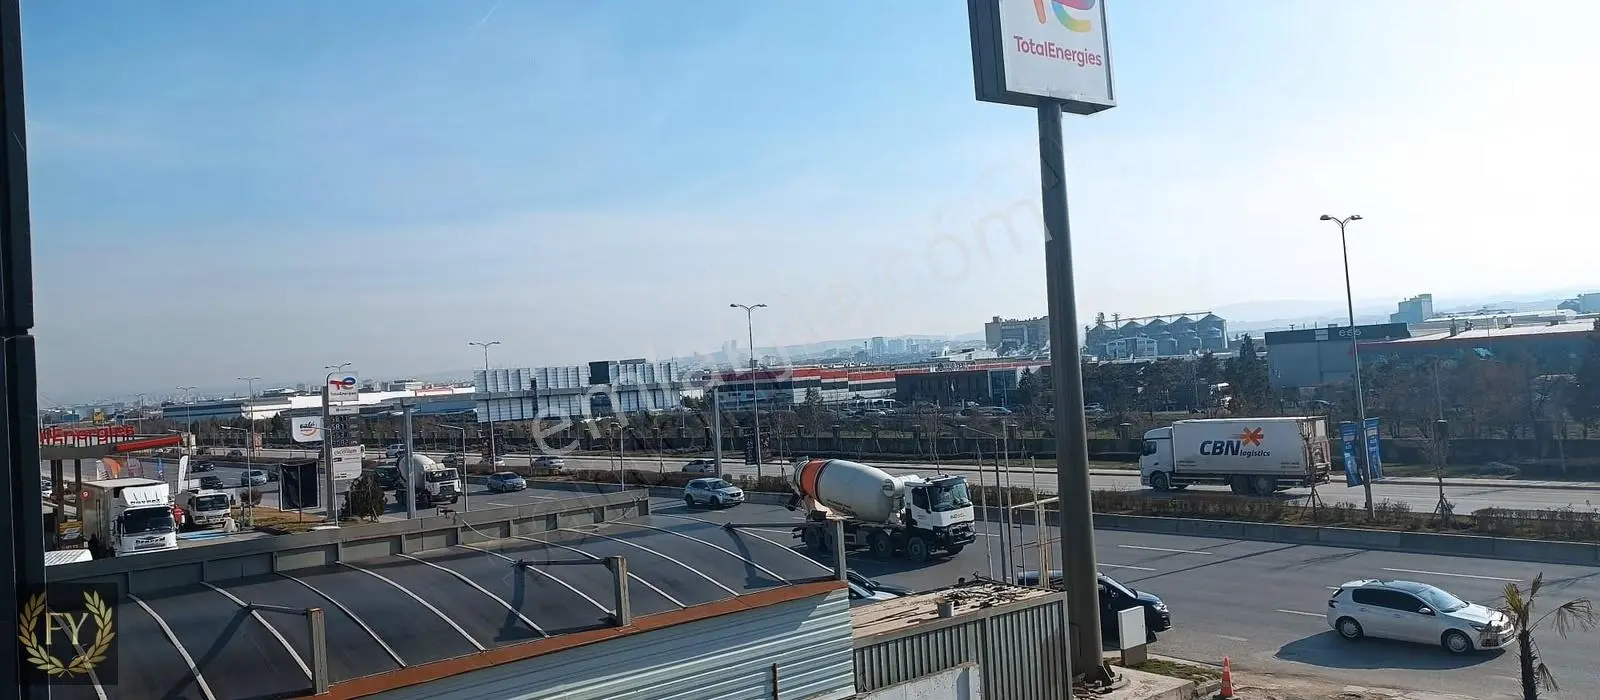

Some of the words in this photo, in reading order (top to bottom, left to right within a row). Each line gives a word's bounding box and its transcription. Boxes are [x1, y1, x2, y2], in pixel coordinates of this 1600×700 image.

[1013, 35, 1102, 67] TotalEnergies
[1200, 440, 1241, 456] CBN
[1240, 449, 1271, 459] logistics
